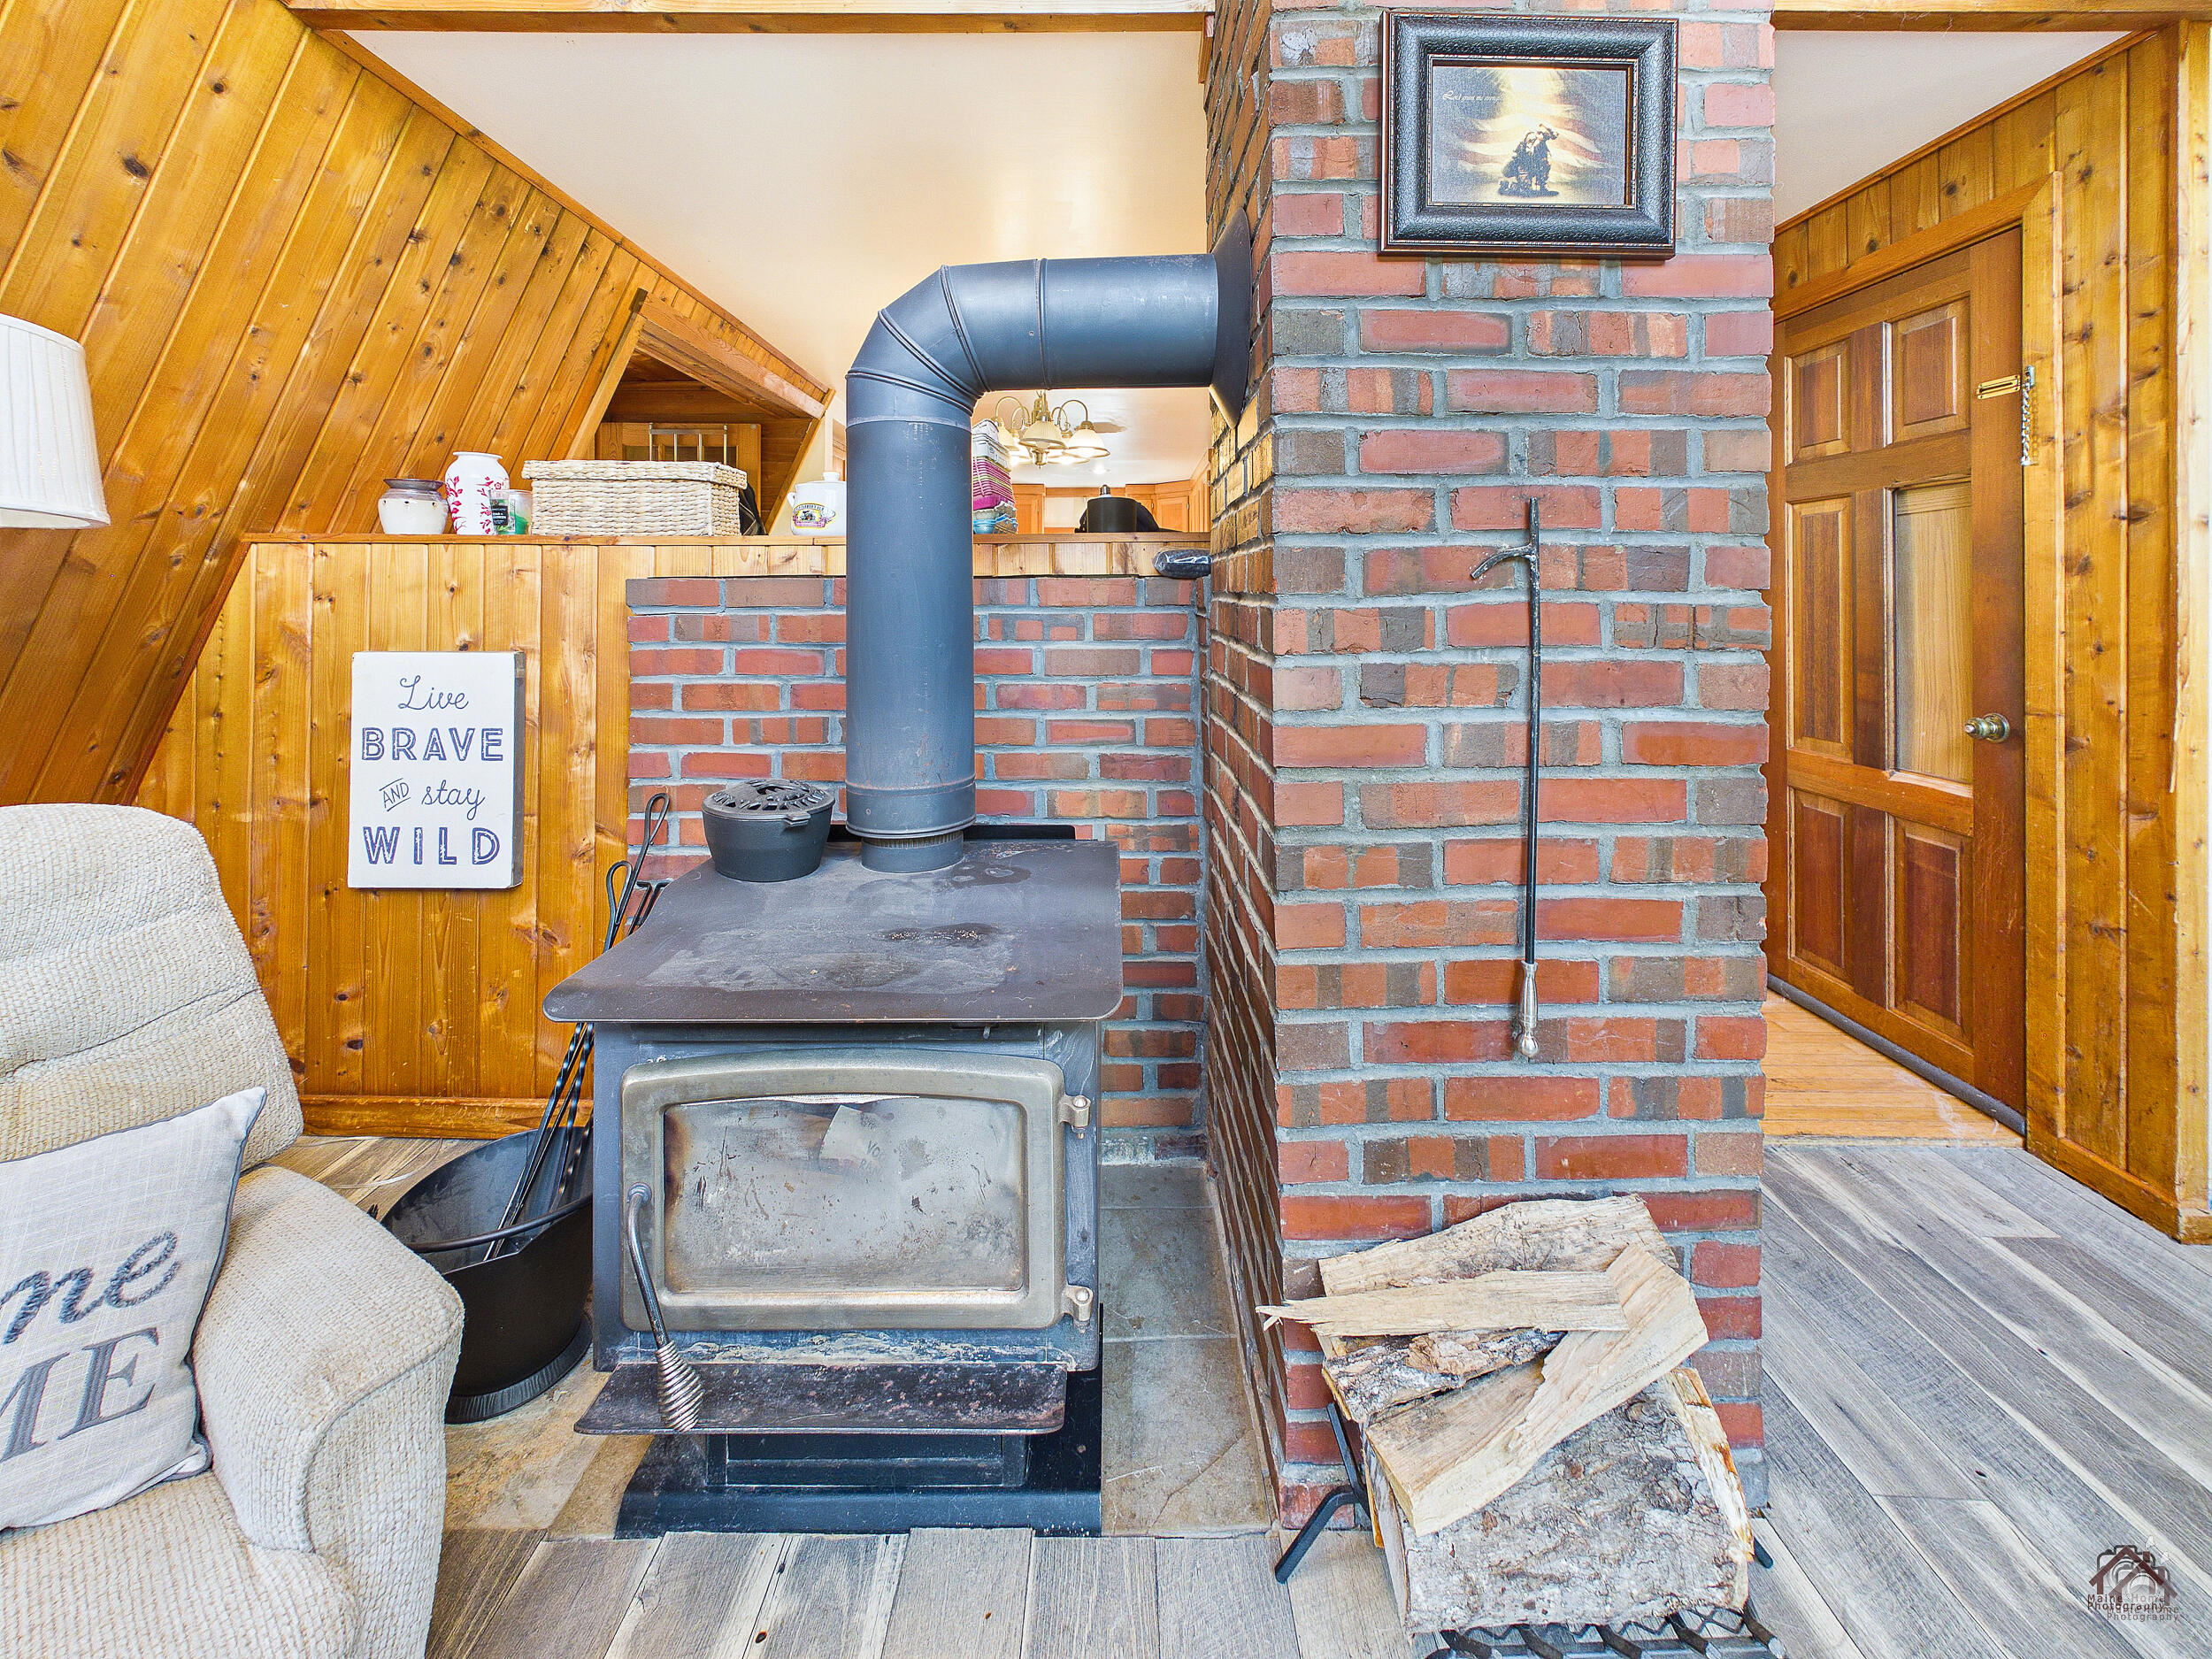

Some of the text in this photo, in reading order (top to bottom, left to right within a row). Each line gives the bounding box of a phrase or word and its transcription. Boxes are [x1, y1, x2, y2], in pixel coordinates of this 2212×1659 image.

[398, 675, 469, 710] Live
[361, 727, 503, 761] BRAVE
[380, 780, 486, 821] AND stay
[363, 826, 500, 864] WILD
